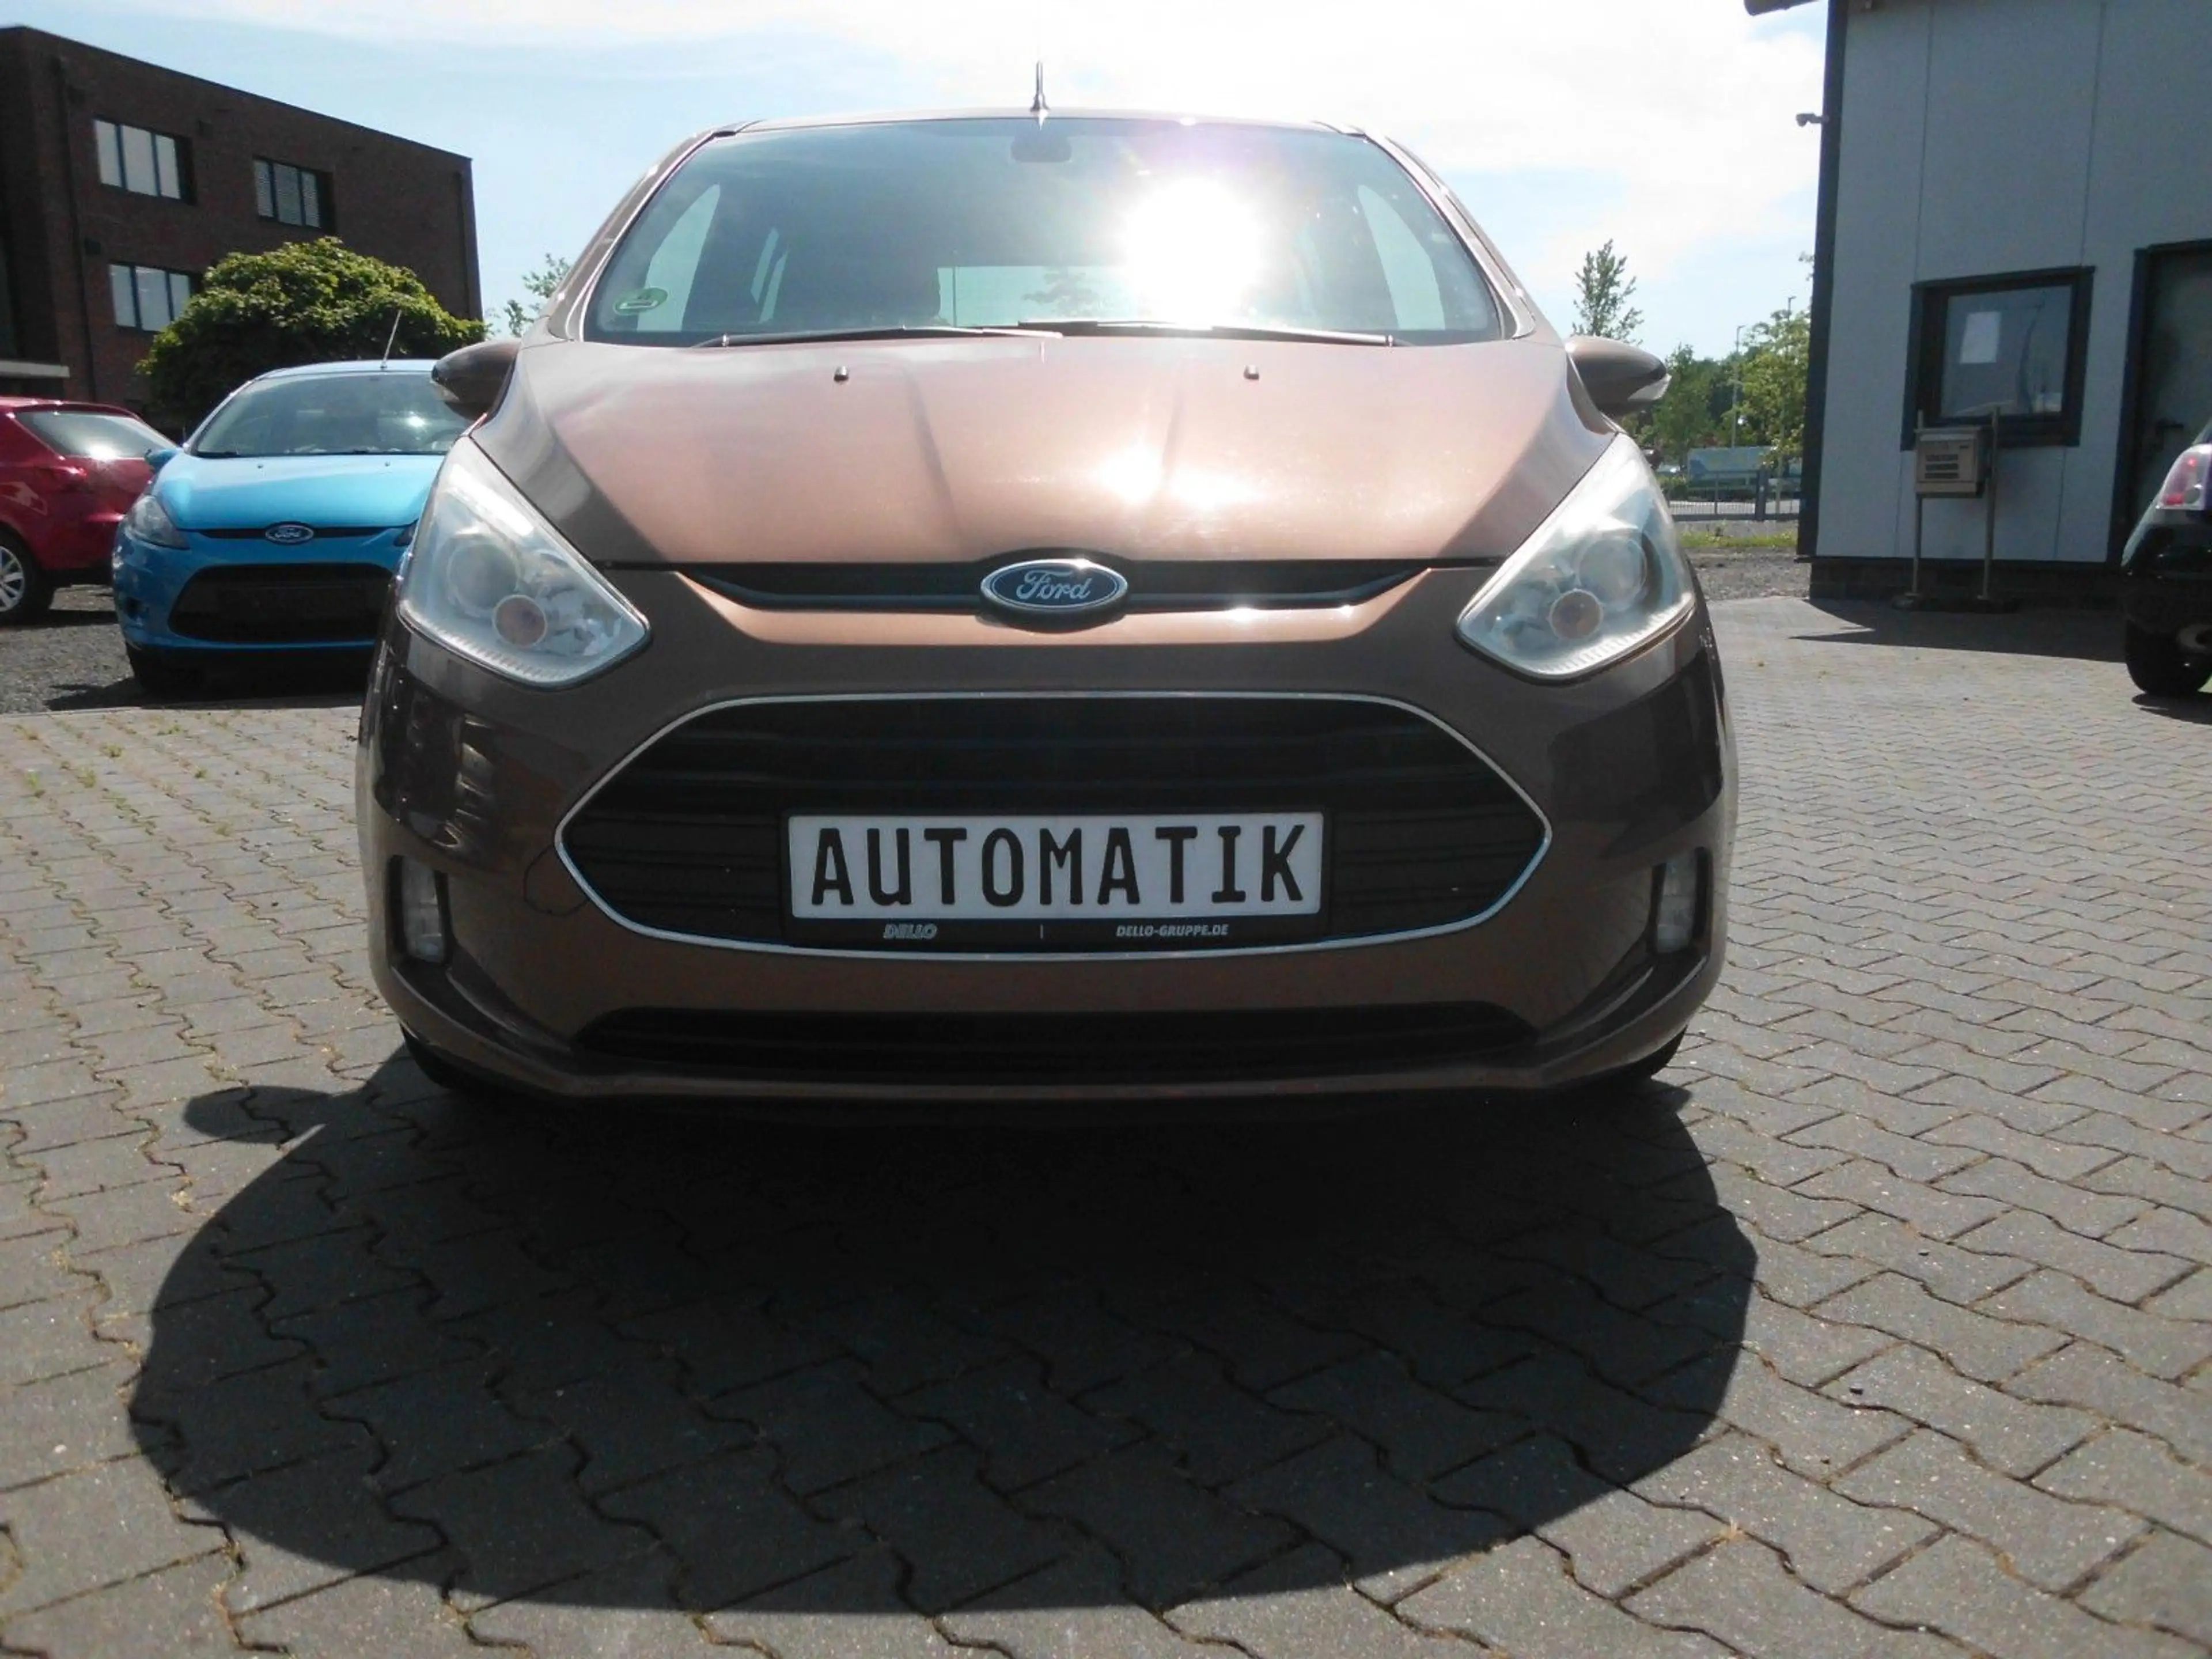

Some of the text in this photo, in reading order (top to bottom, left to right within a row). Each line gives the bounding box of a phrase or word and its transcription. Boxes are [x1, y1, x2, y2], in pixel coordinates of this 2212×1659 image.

[1016, 569, 1093, 600] Ford
[811, 824, 1306, 907] AUTOMATIK
[1116, 923, 1229, 938] DELLO-GRUPPE.DE
